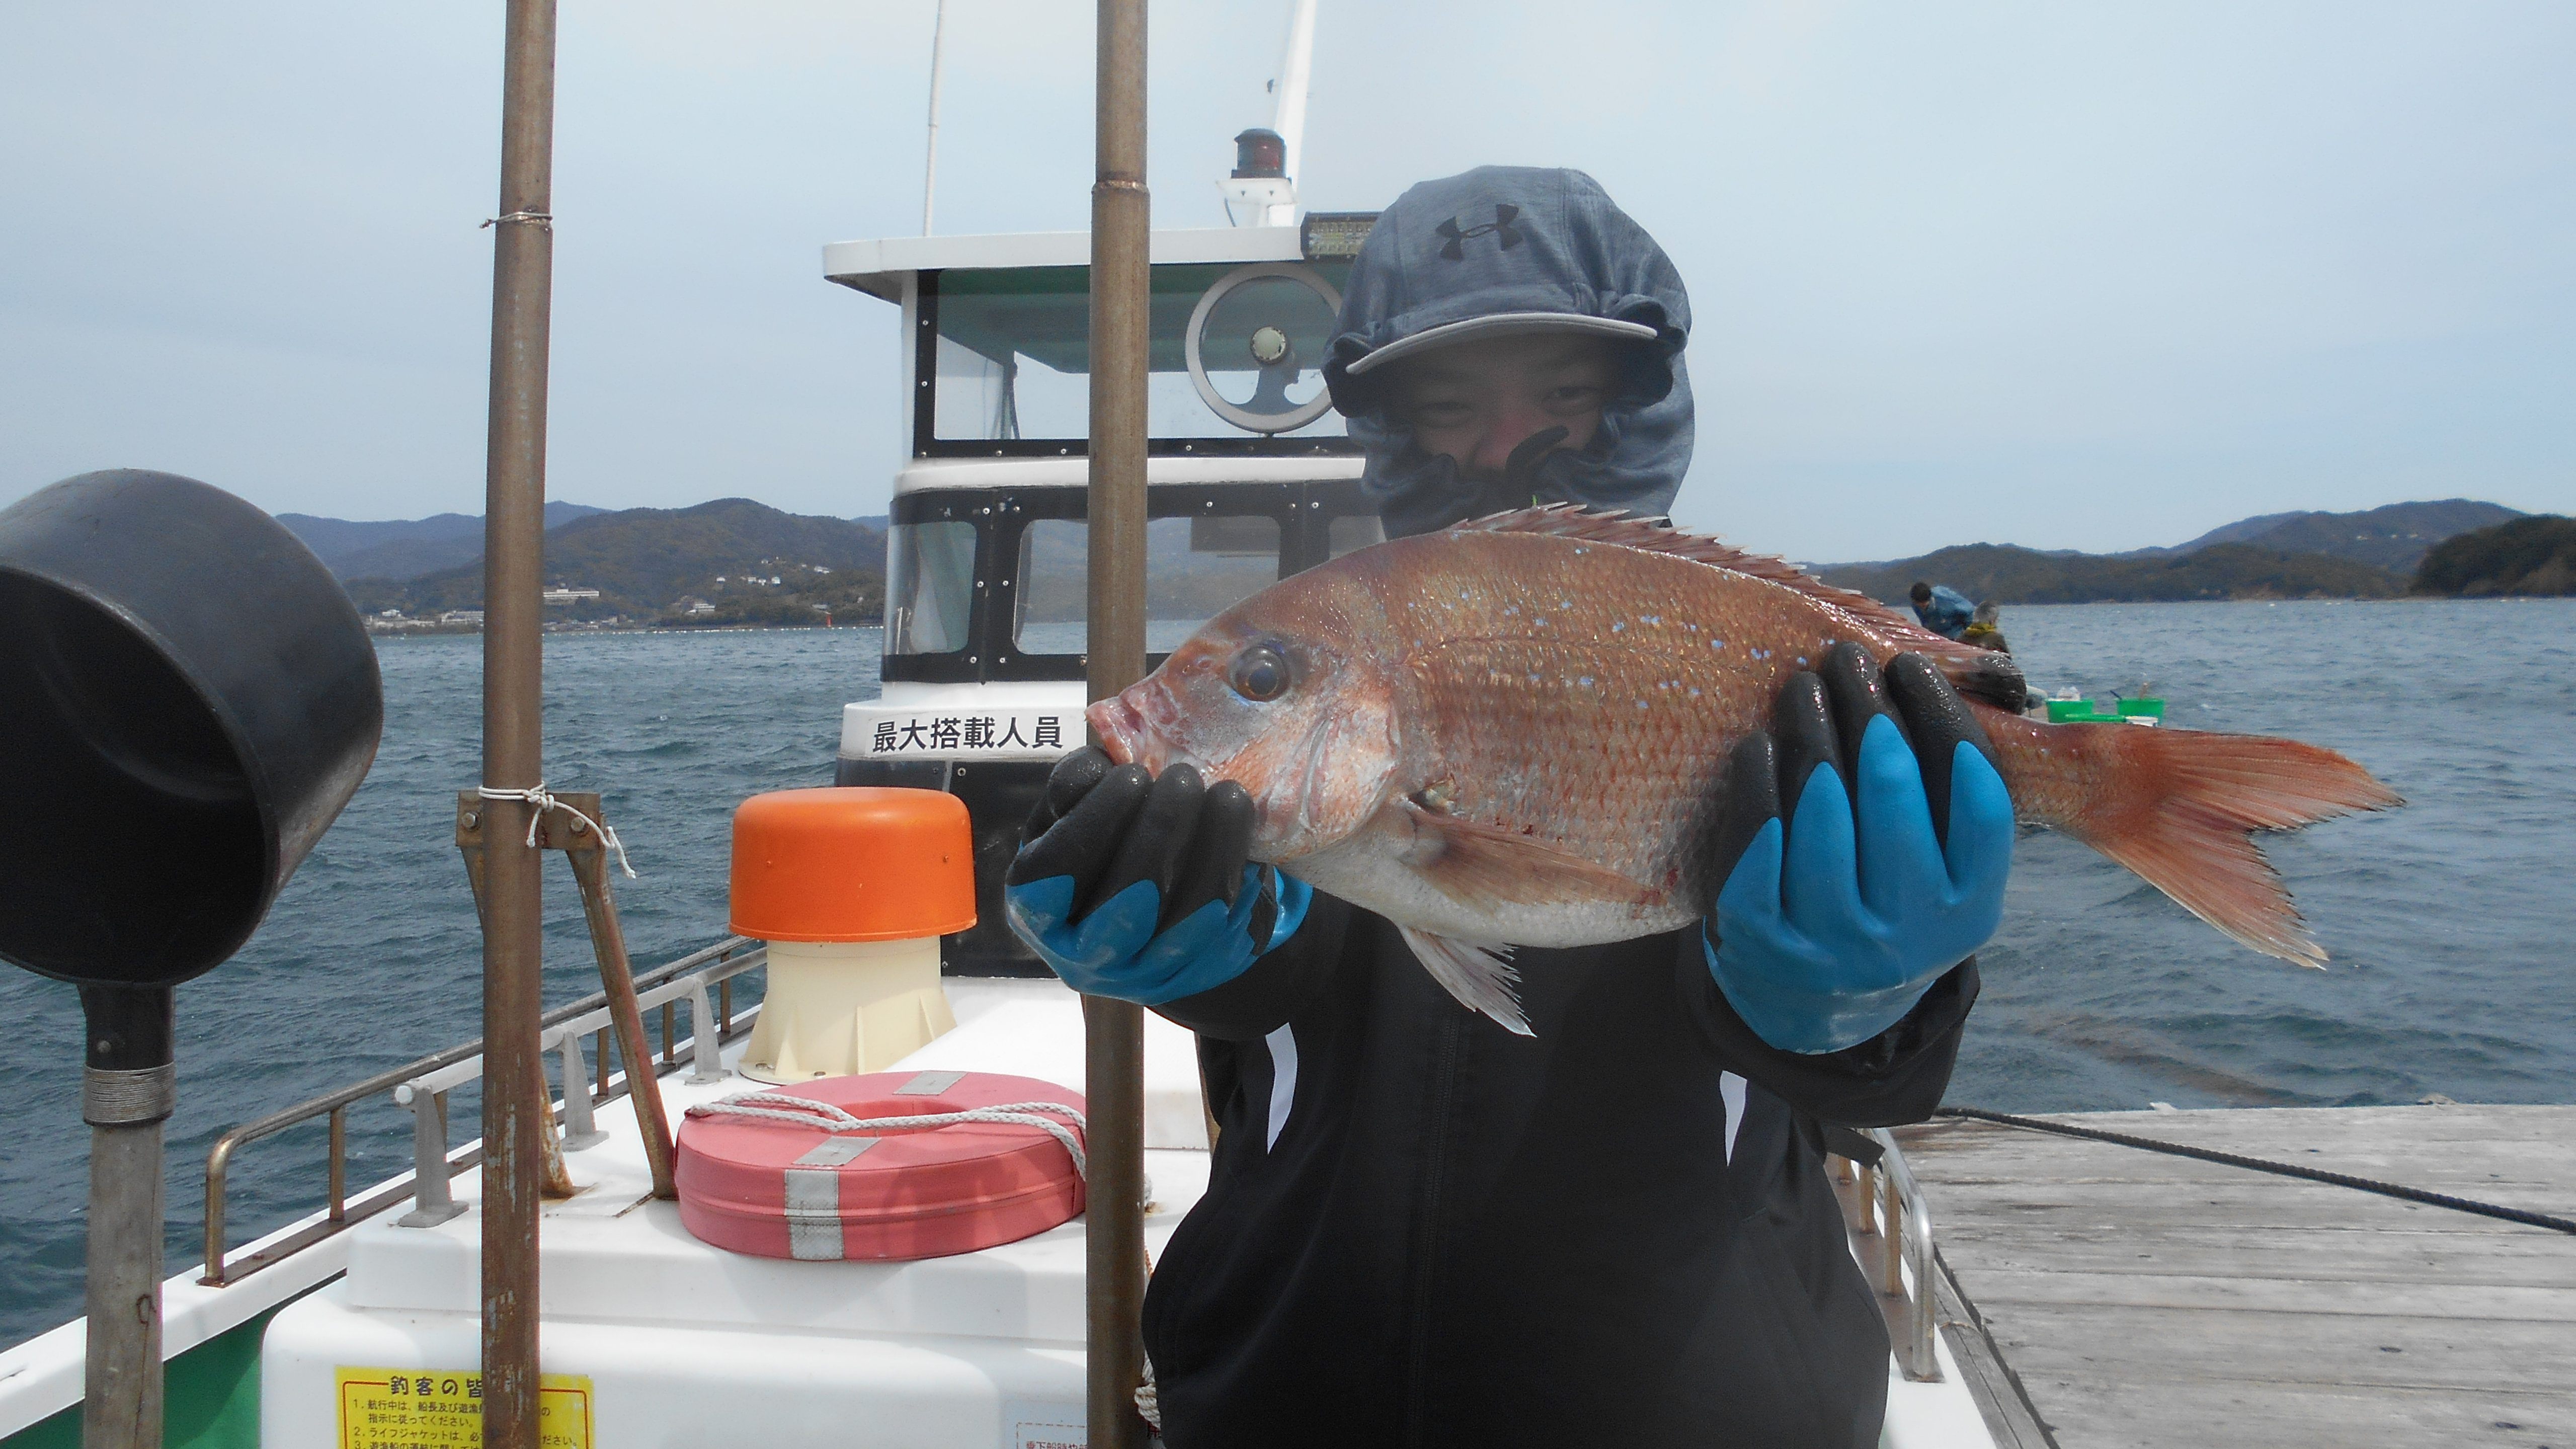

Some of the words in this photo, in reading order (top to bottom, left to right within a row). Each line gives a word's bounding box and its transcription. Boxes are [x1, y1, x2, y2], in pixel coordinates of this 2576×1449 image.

[872, 716, 1064, 753] 最大搭載人員
